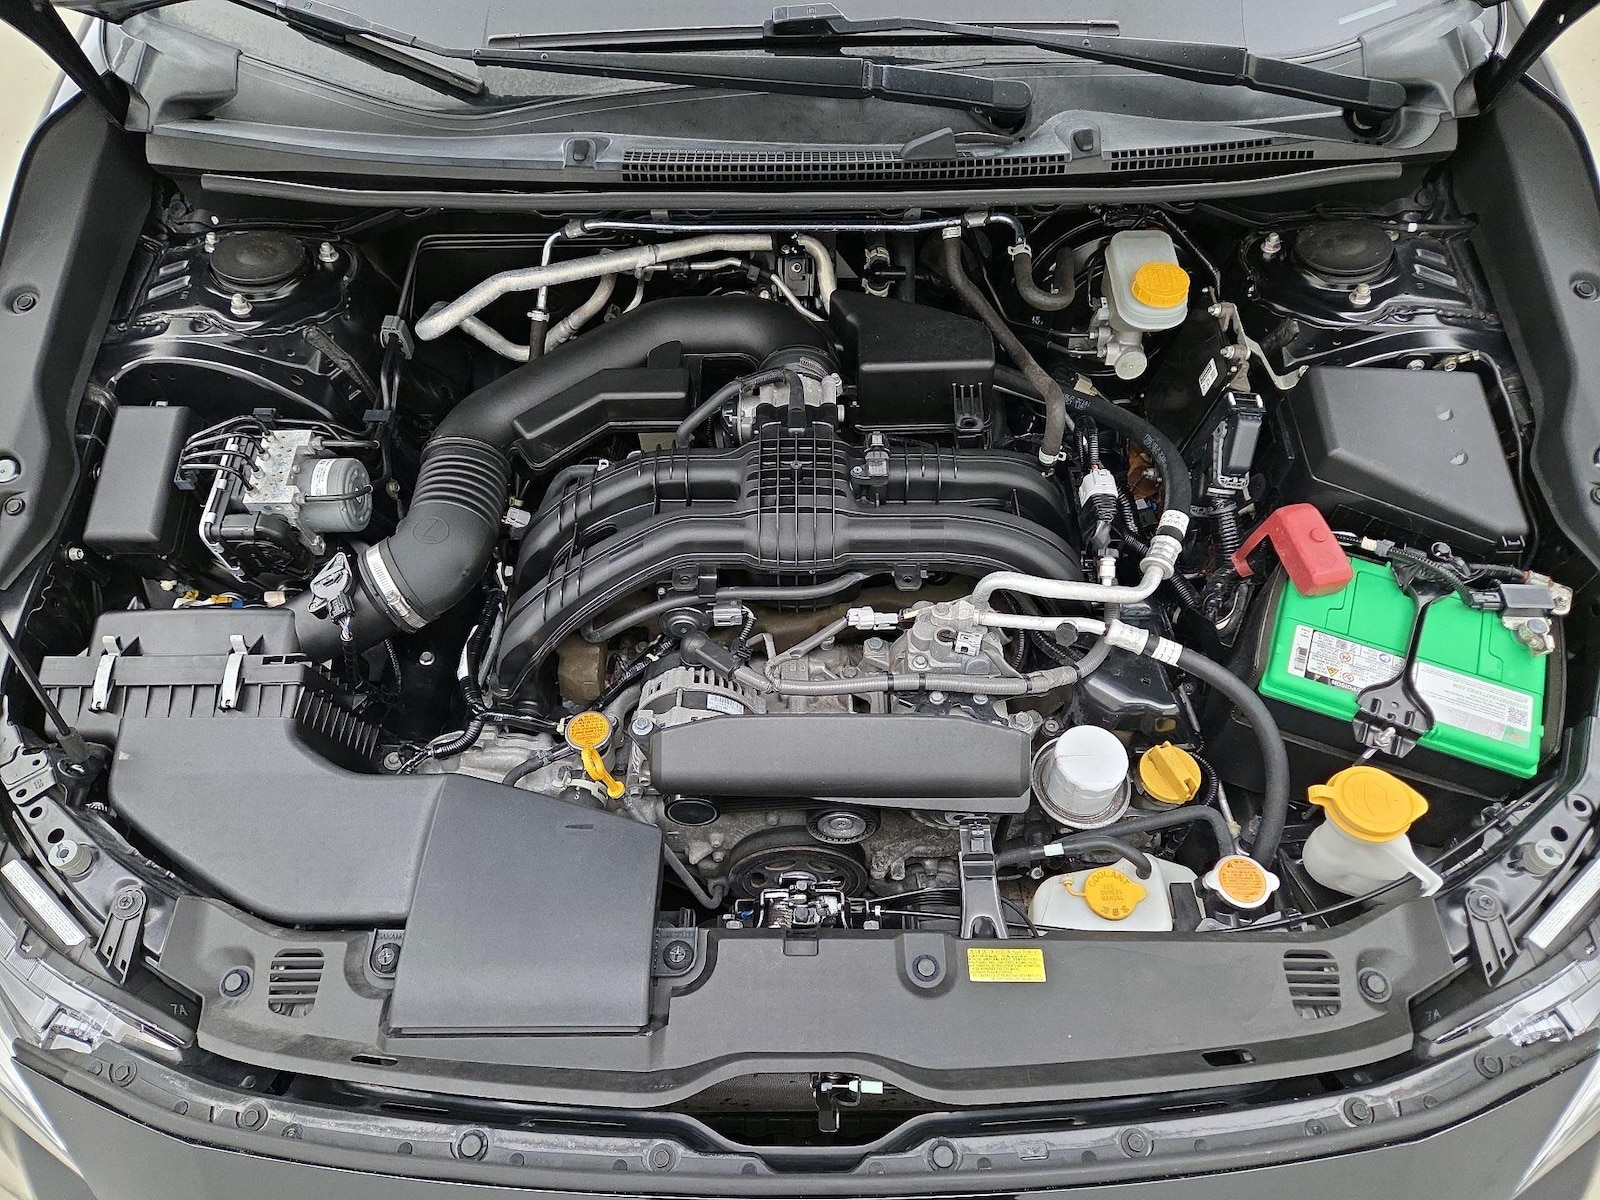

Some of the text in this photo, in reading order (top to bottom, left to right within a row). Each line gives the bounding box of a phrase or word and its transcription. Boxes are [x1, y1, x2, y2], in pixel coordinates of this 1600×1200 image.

[1331, 680, 1362, 693] /POISON
[1088, 870, 1130, 887] COOLANT
[169, 1003, 188, 1016] 7A
[1424, 1008, 1442, 1022] 7A
